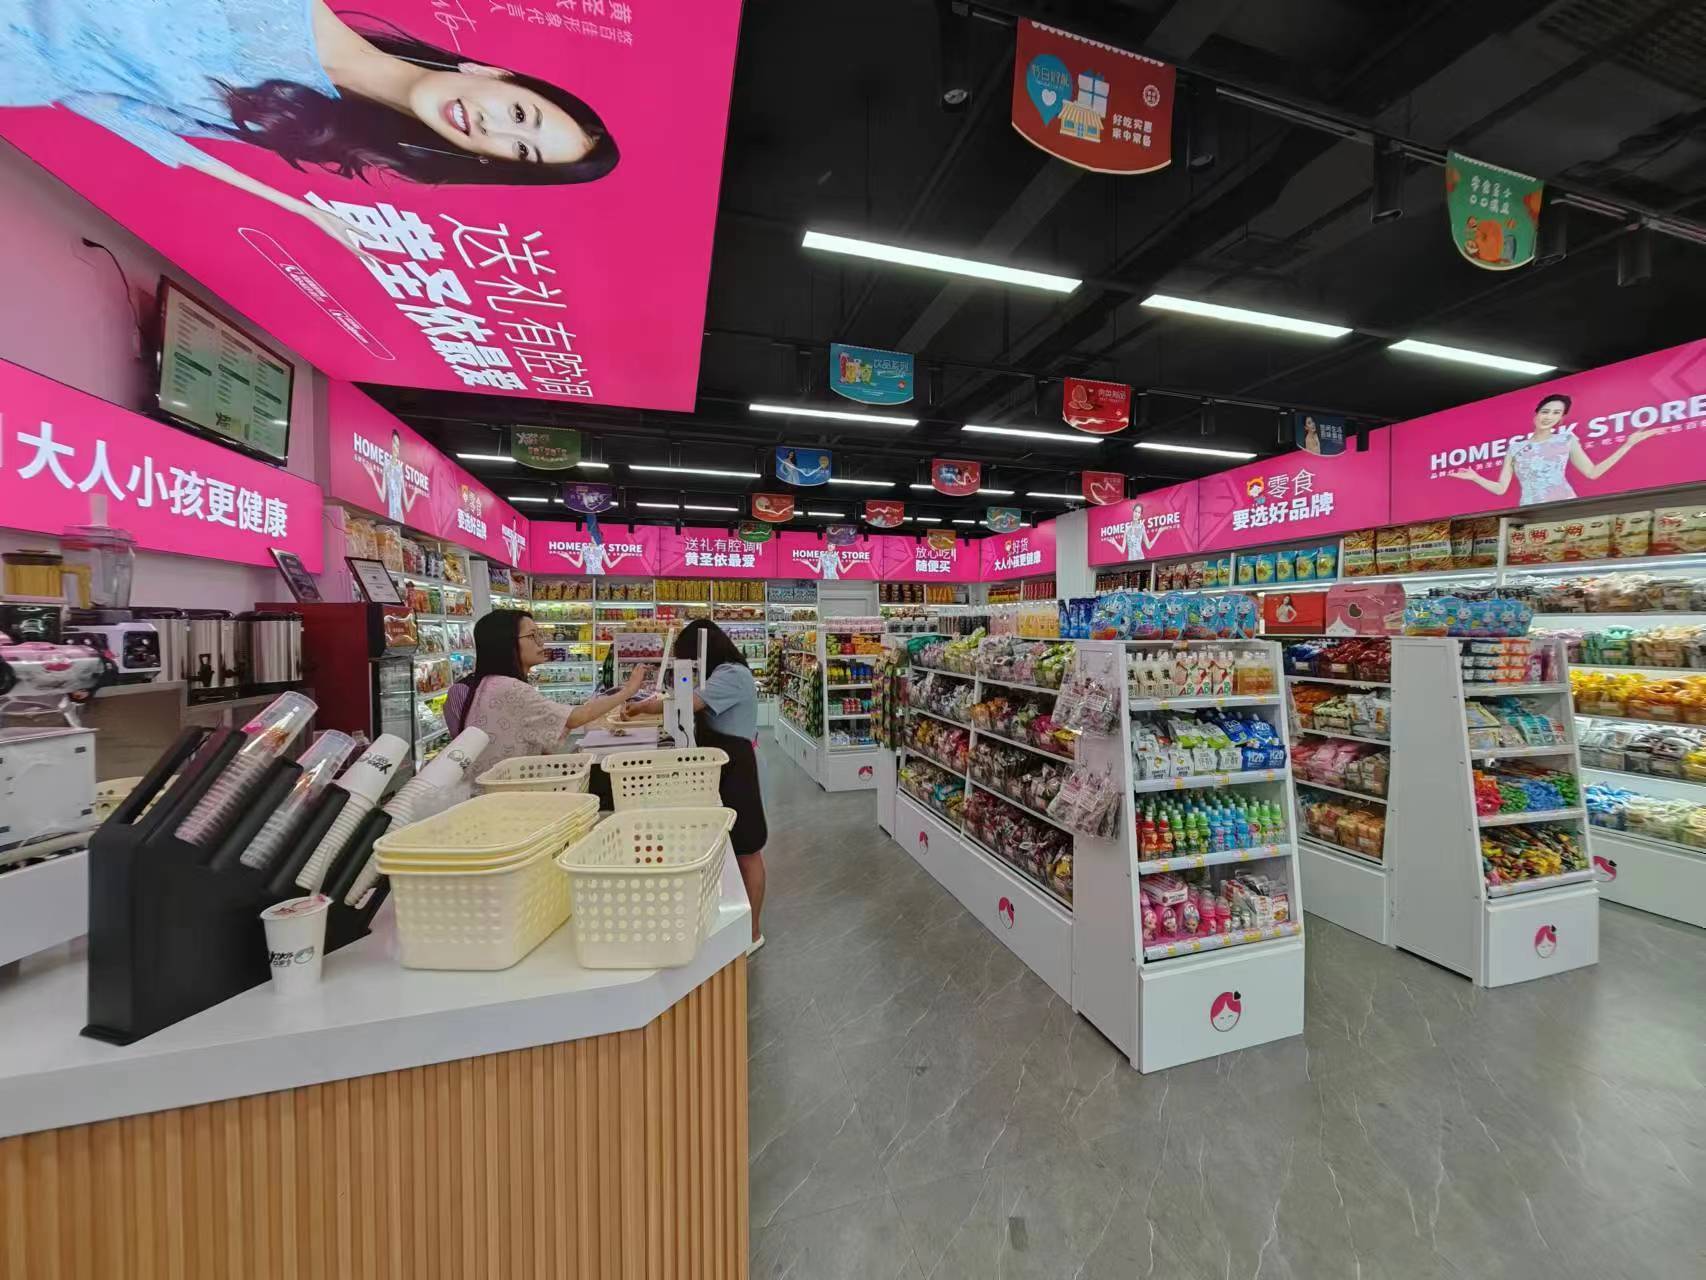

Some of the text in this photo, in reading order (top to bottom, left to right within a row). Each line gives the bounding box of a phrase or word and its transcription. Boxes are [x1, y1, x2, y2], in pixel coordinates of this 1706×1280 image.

[304, 190, 528, 391] 黄圣依最爱
[438, 213, 593, 397] 送礼有腔调
[1586, 394, 1706, 438] STORE
[17, 420, 289, 538] 大人小孩更健康
[405, 464, 430, 491] STORE
[1266, 468, 1316, 500] 零食
[1147, 512, 1181, 529] STORE
[1231, 491, 1335, 532] 要选好品牌
[608, 543, 643, 553] STORE
[684, 536, 757, 554] 送礼有腔调
[841, 551, 870, 560] STORE
[1012, 538, 1029, 554] 好货
[684, 551, 756, 568] 黄圣依最爱
[915, 559, 951, 573] 随便买
